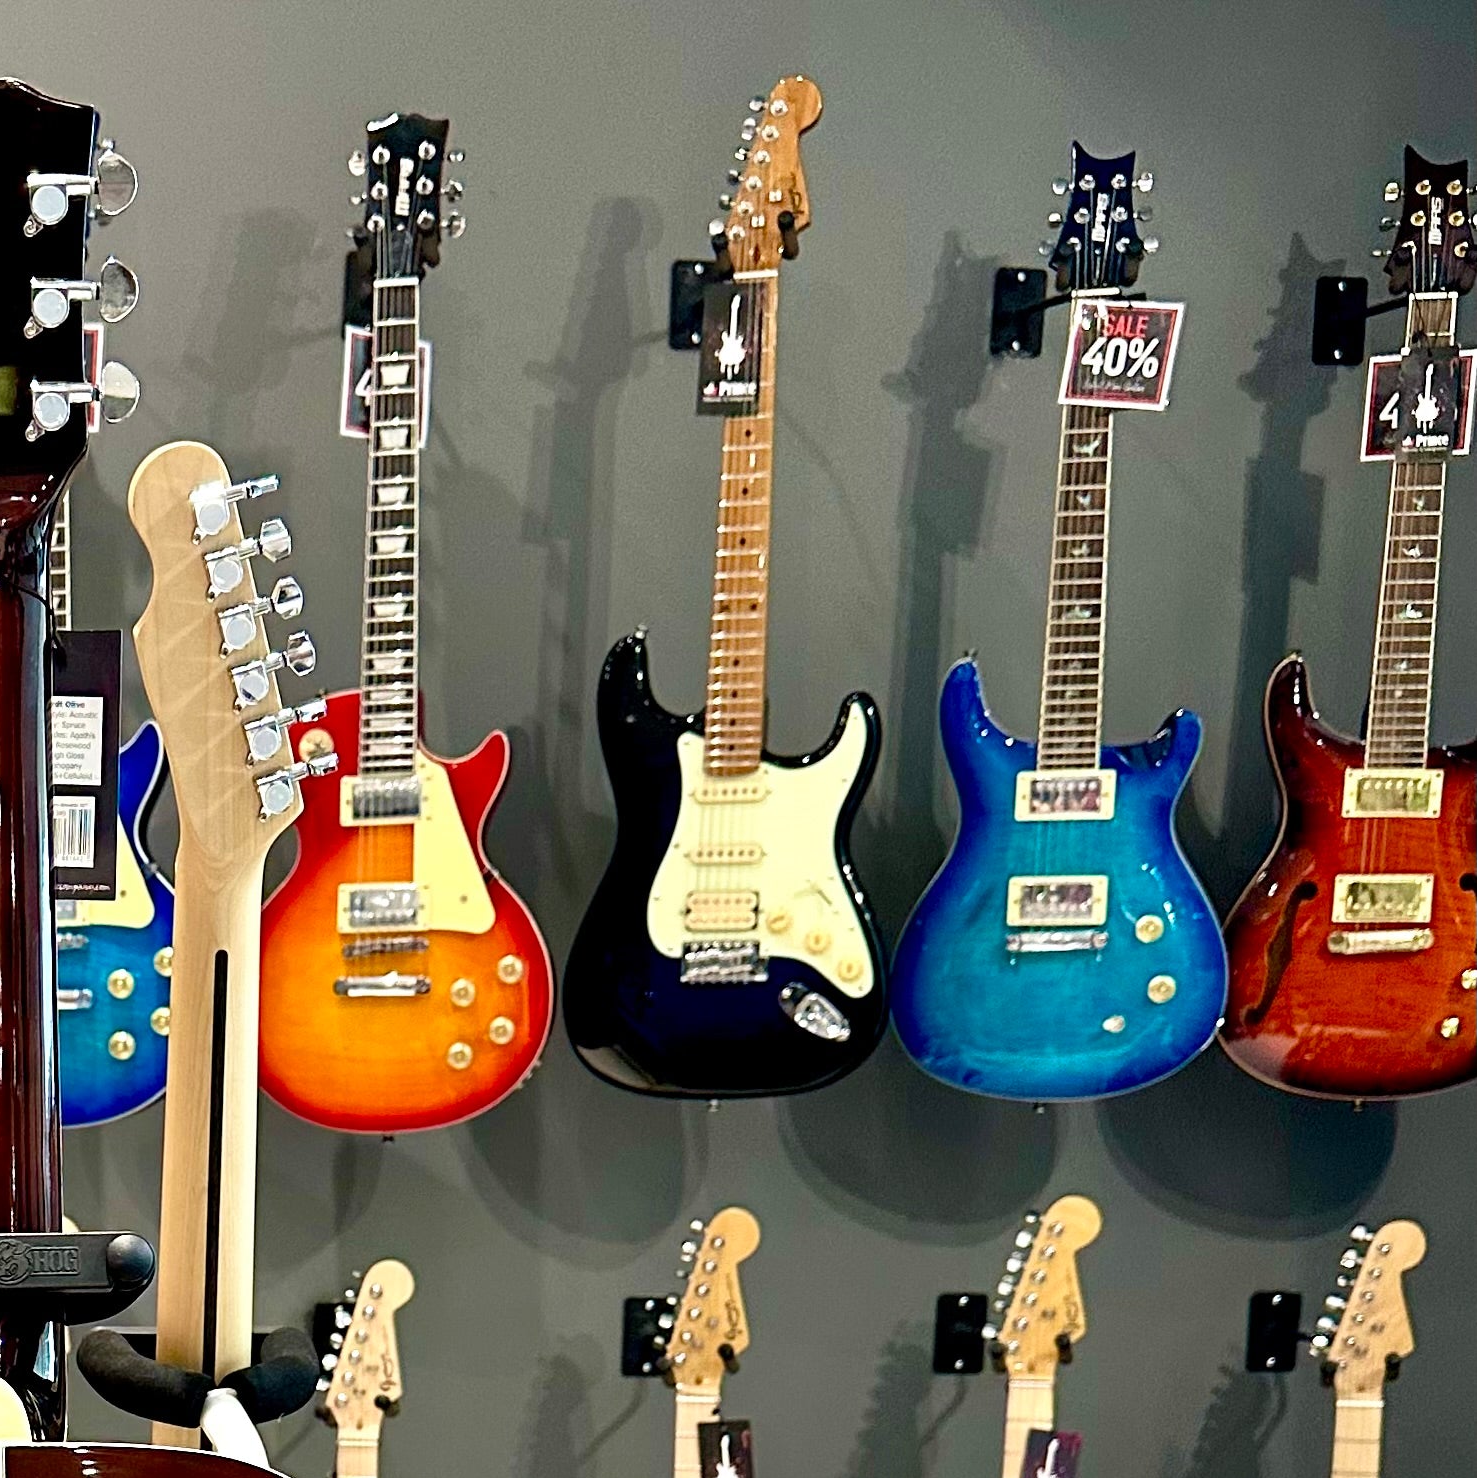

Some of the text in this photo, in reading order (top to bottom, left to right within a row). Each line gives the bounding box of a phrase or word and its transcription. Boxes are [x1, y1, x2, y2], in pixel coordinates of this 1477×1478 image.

[1103, 313, 1150, 338] SALE
[1080, 336, 1160, 379] 40%
[32, 1249, 79, 1272] HOG
